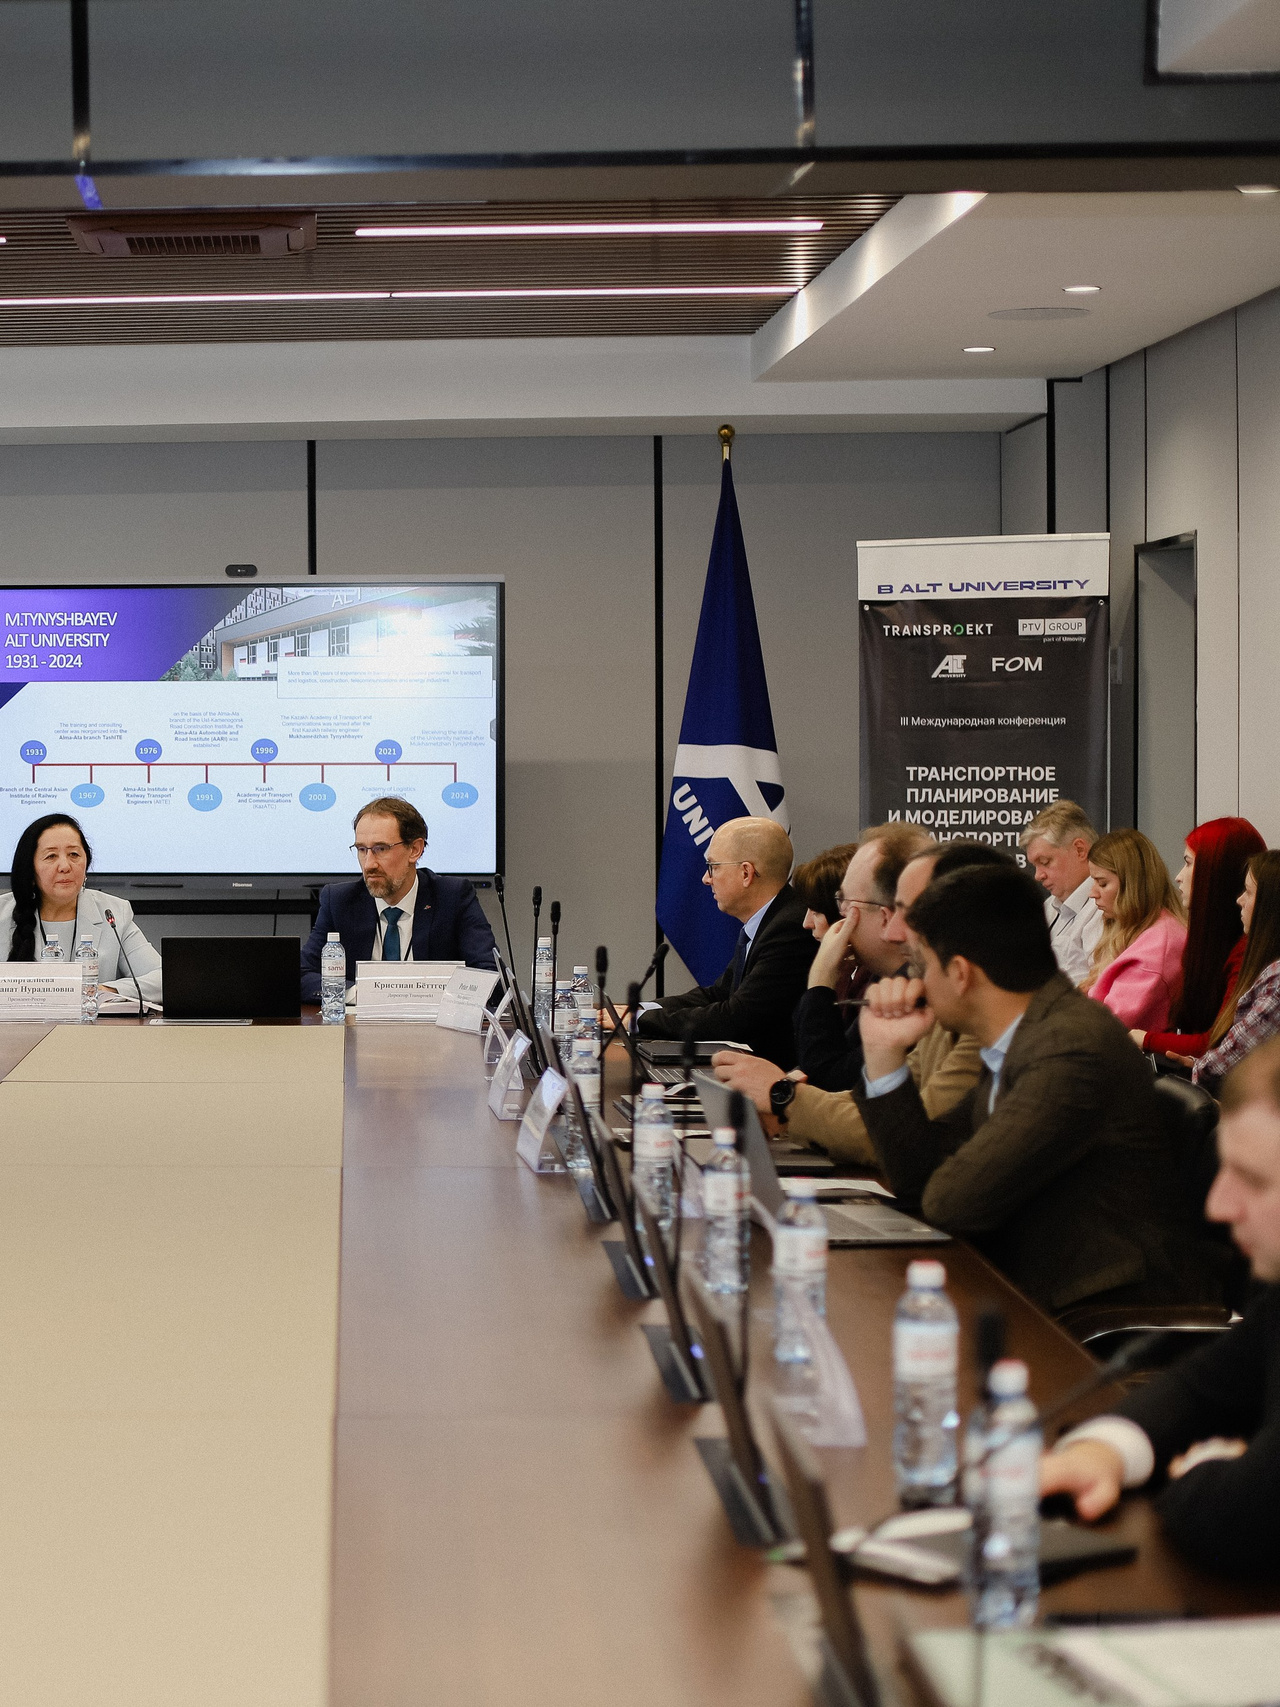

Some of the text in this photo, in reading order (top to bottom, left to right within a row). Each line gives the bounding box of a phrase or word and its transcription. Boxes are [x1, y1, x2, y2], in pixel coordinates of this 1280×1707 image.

[900, 582, 943, 594] ALT
[949, 579, 1090, 593] UNIVERSITY
[5, 612, 118, 627] M.TYNYSHBAYEV
[1022, 622, 1083, 632] PTV GROUP
[883, 623, 994, 637] TRANSPROEKT
[4, 632, 110, 648] ALT UNIVERSITY
[5, 654, 39, 669] 1931
[48, 654, 83, 669] 2024
[991, 656, 1043, 672] FOM
[911, 716, 995, 727] Международная
[997, 716, 1066, 727] конференция
[26, 748, 43, 756] 1931
[906, 766, 1056, 782] ТРАНСПОРТНОЕ
[308, 793, 326, 801] 2003
[906, 788, 1060, 804] ПЛАНИРОВАНИЕ
[888, 810, 1040, 828] И МОДЕЛИРОВА
[20, 986, 74, 994] Нурадиловна
[374, 982, 414, 990] Кристиан
